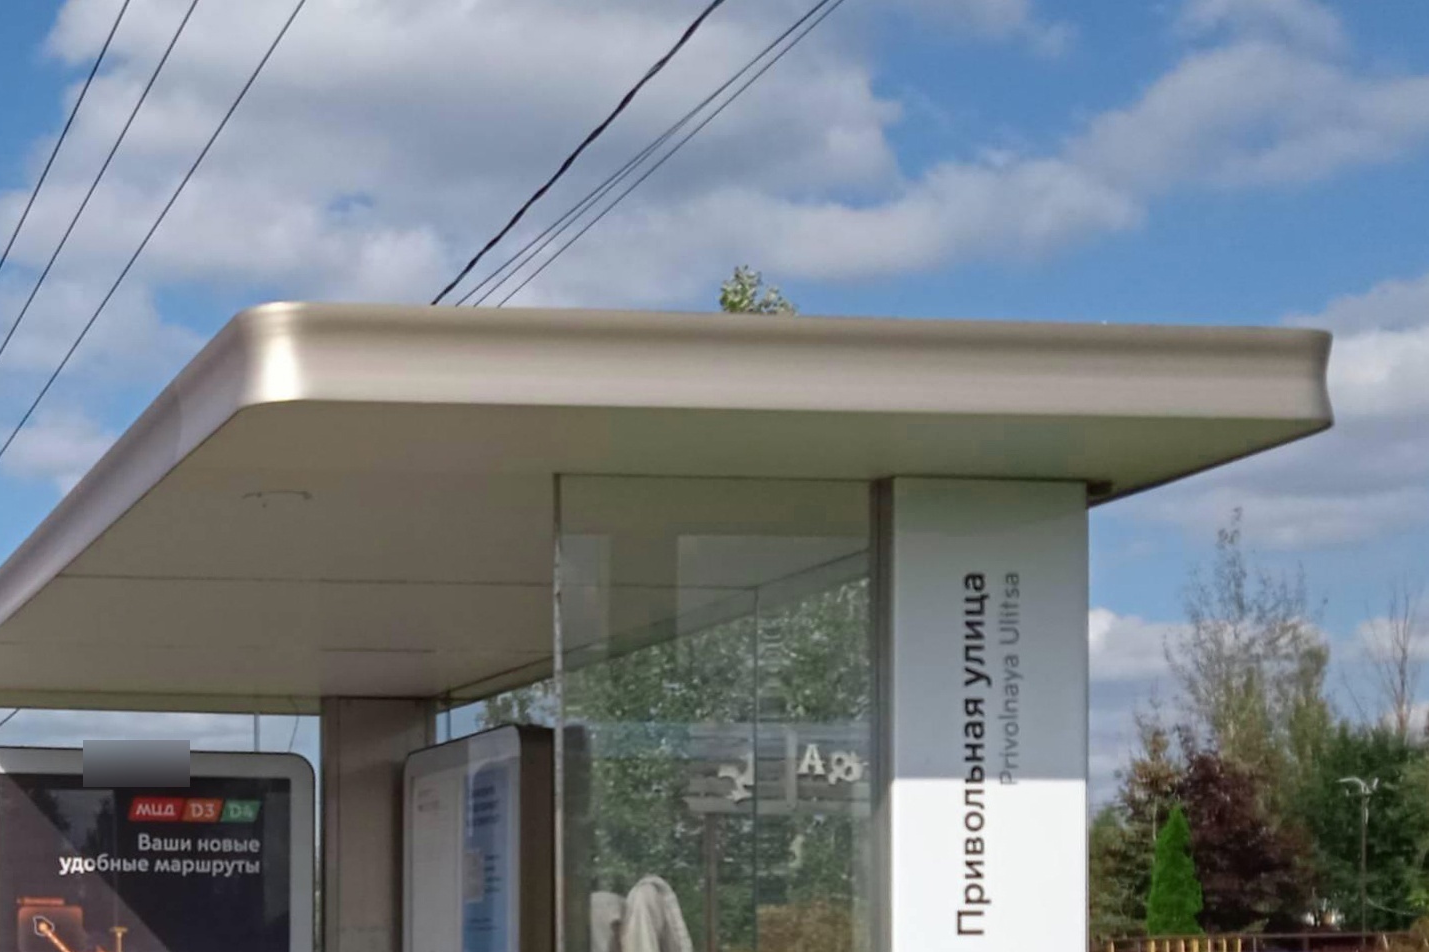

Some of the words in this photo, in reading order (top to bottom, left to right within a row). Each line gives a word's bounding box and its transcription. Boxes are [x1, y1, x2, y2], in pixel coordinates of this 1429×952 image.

[963, 572, 991, 688] улица
[998, 571, 1020, 645] Ulitsa
[998, 653, 1024, 786] Privolnaya
[138, 834, 192, 851] Ваши
[198, 837, 261, 853] новые
[191, 803, 215, 817] D3
[229, 803, 254, 818] D4
[957, 698, 991, 935] Привольная
[58, 854, 150, 876] удобные
[154, 857, 261, 877] маршруты
